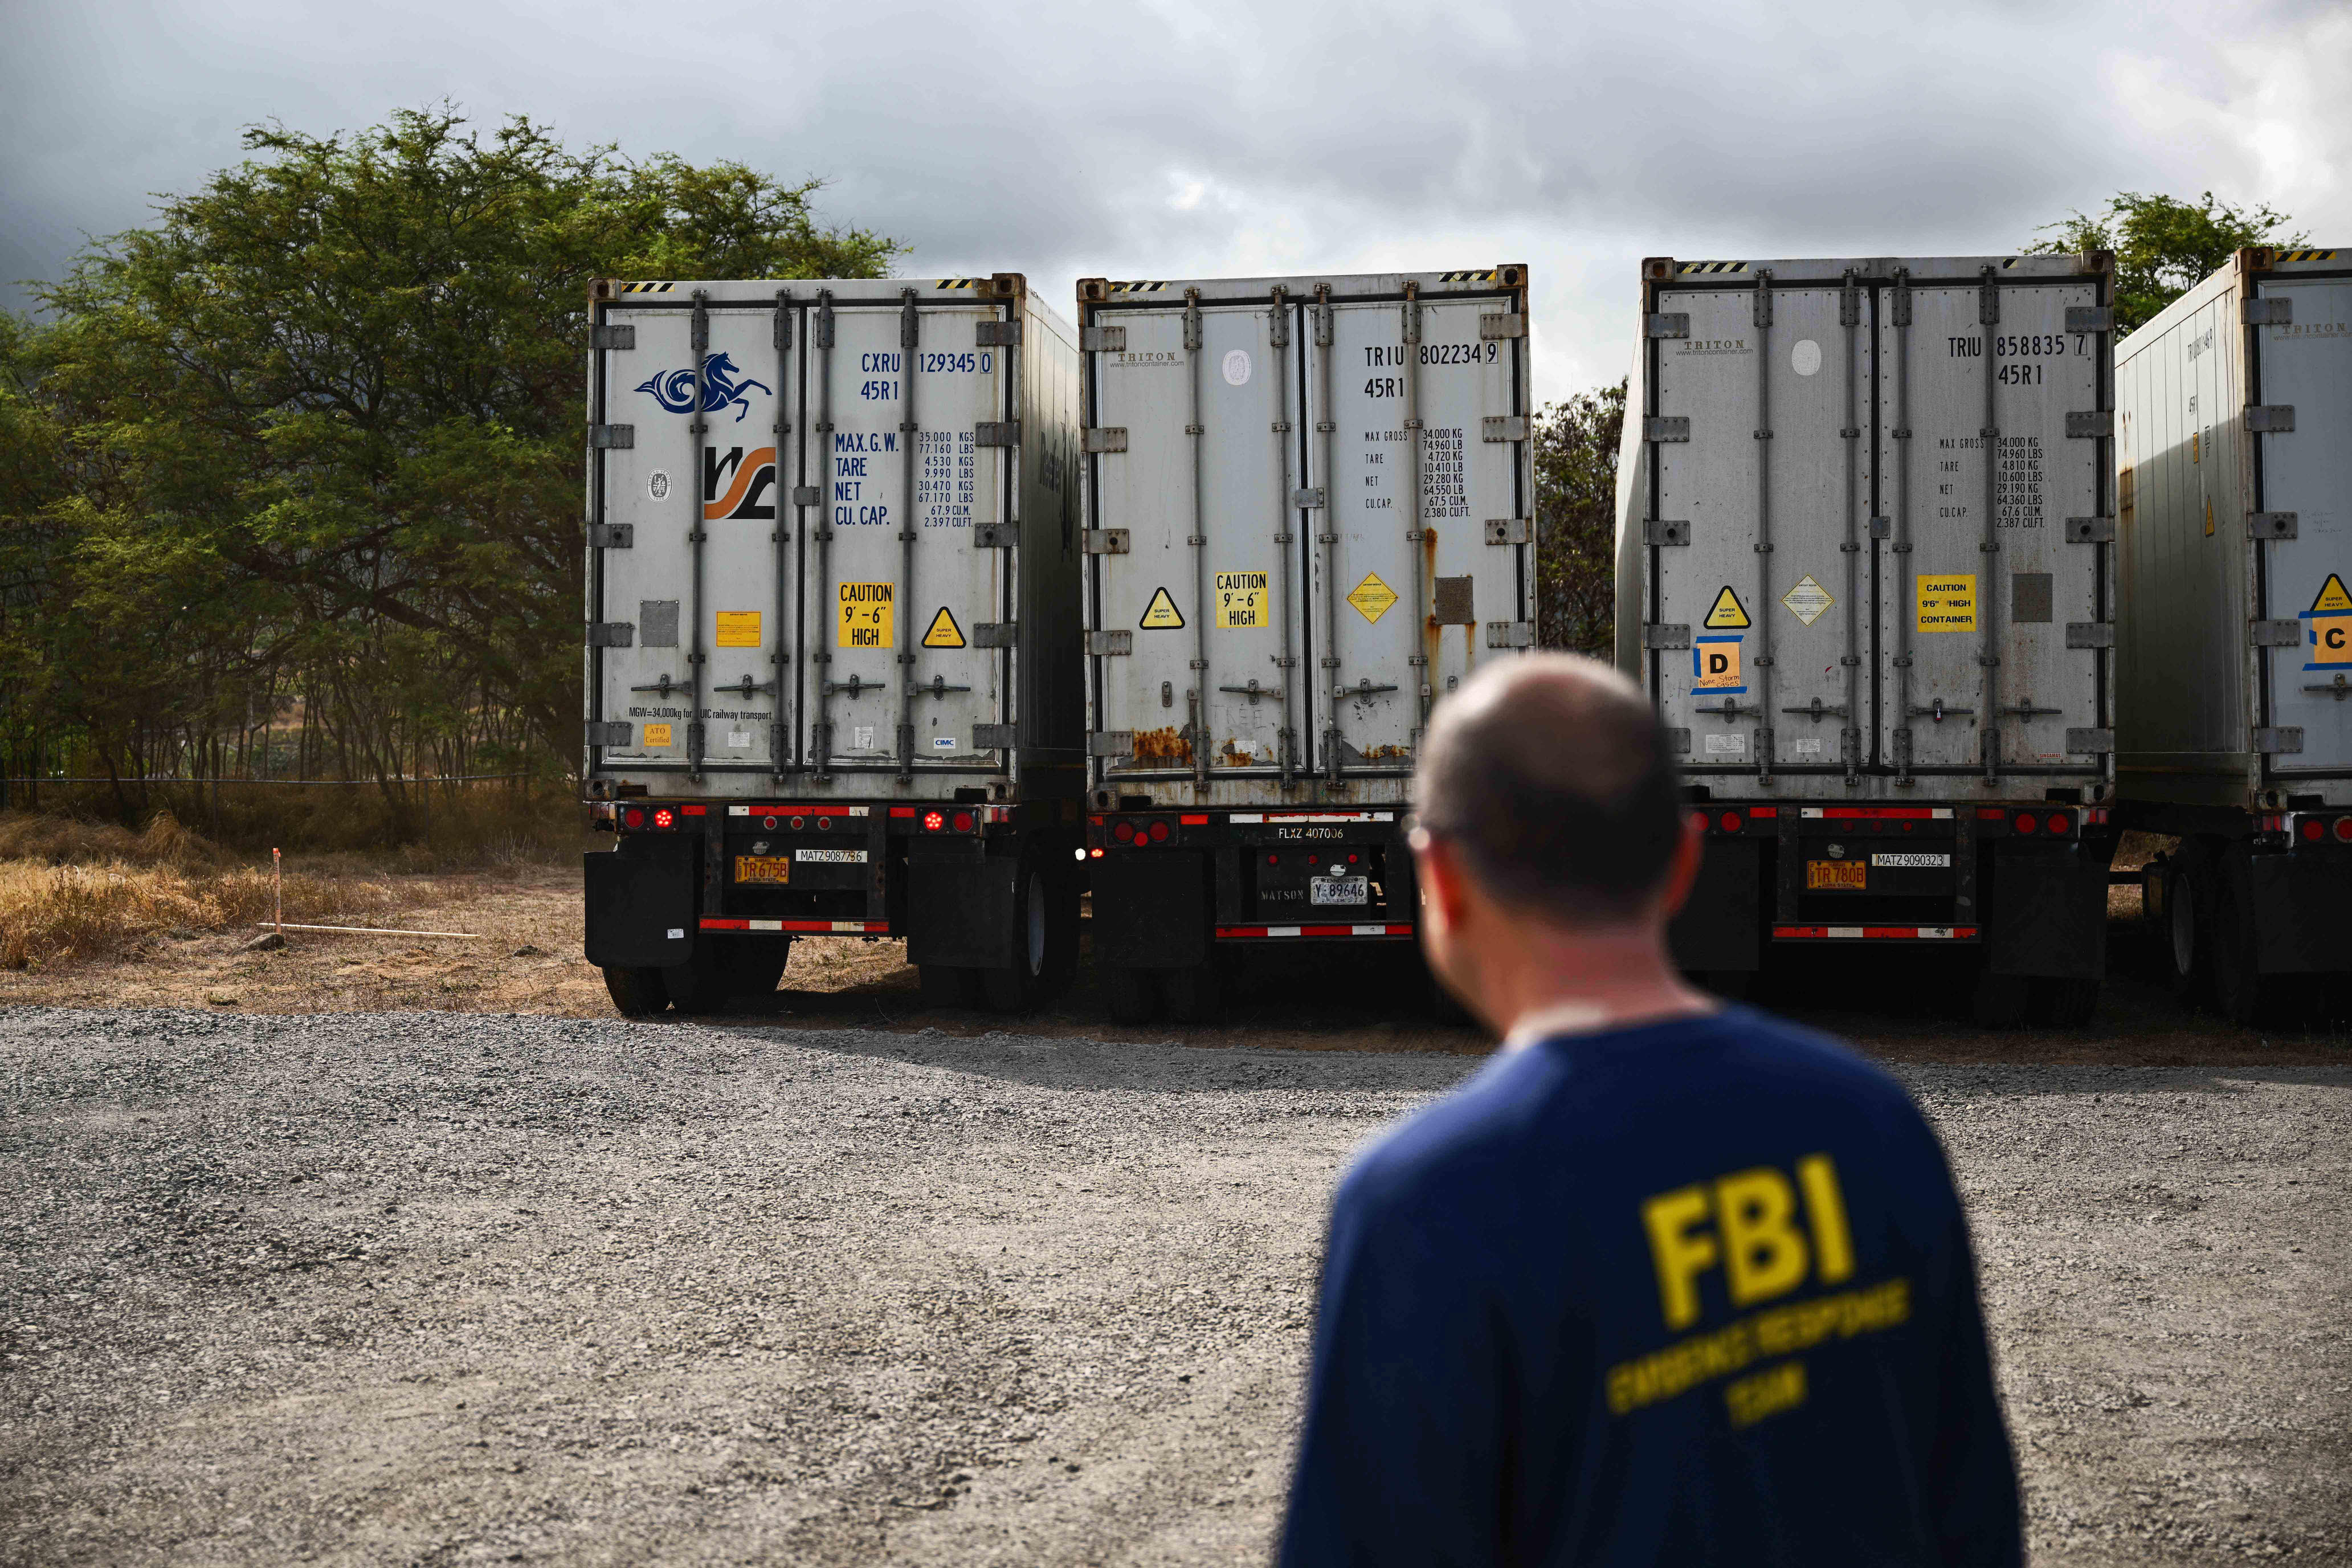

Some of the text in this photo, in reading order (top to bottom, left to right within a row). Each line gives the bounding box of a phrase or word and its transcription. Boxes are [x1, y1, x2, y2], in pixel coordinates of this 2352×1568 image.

[2282, 322, 2346, 334] TRITON
[1684, 340, 1743, 349] TRITON
[1948, 337, 1981, 357] TRIU
[1997, 335, 2065, 356] 858835
[1118, 353, 1175, 361] TRITON
[1365, 346, 1404, 366] TRIU
[1420, 344, 1481, 365] 802234
[862, 353, 900, 372] CXRU
[919, 353, 975, 372] 129345
[1998, 365, 2041, 385] 45R1
[861, 381, 898, 399] 45R1
[1364, 378, 1403, 398] 45R1
[2189, 394, 2198, 416] 45R1
[959, 432, 974, 442] KGS
[1365, 431, 1408, 442] MAX GROSS
[1452, 428, 1462, 438] KG
[1453, 440, 1463, 450] LB
[1940, 438, 1984, 449] MAX GROSS
[2028, 437, 2038, 447] KG
[959, 444, 974, 454] LBS
[2028, 449, 2043, 459] LBS
[959, 456, 974, 466] KGS
[1366, 454, 1383, 464] TARE
[1453, 451, 1463, 461] KG
[836, 458, 867, 476] TARE
[1453, 462, 1463, 472] LB
[1940, 462, 1959, 472] TARE
[2028, 460, 2038, 470] KG
[959, 468, 974, 478] LBS
[1453, 473, 1463, 483] KG
[2028, 472, 2043, 482] LBS
[958, 481, 974, 491] KGS
[1366, 476, 1378, 486] NET
[835, 482, 861, 501] NET
[1454, 485, 1463, 495] LB
[1940, 484, 1953, 495] NET
[2028, 483, 2038, 493] KG
[958, 493, 973, 503] LBS
[1430, 496, 1468, 506] 67.5 CU.M.
[2028, 495, 2043, 505] LBS
[931, 505, 971, 515] 67.9 CU.M.
[1449, 507, 1470, 517] CU.FT.
[2002, 507, 2043, 516] 67.6 CU.M.
[952, 517, 973, 527] CU.FT.
[2023, 518, 2045, 528] CU.FT.
[1217, 574, 1266, 590] CAUTION
[840, 585, 892, 602] CAUTION
[1229, 610, 1255, 625] HIGH
[852, 628, 879, 645] HIGH
[2325, 628, 2346, 649] C
[1710, 654, 1728, 673] D
[1699, 679, 1716, 687] None
[683, 709, 693, 718] for
[700, 709, 712, 718] UIC
[713, 709, 738, 721] railway
[740, 710, 771, 722] transport
[1279, 828, 1344, 839] FLXZ 407006
[743, 862, 787, 877] TR 675B
[1815, 868, 1864, 883] TR 780B
[1261, 889, 1304, 900] MATSON
[1641, 1152, 1854, 1330] FBI
